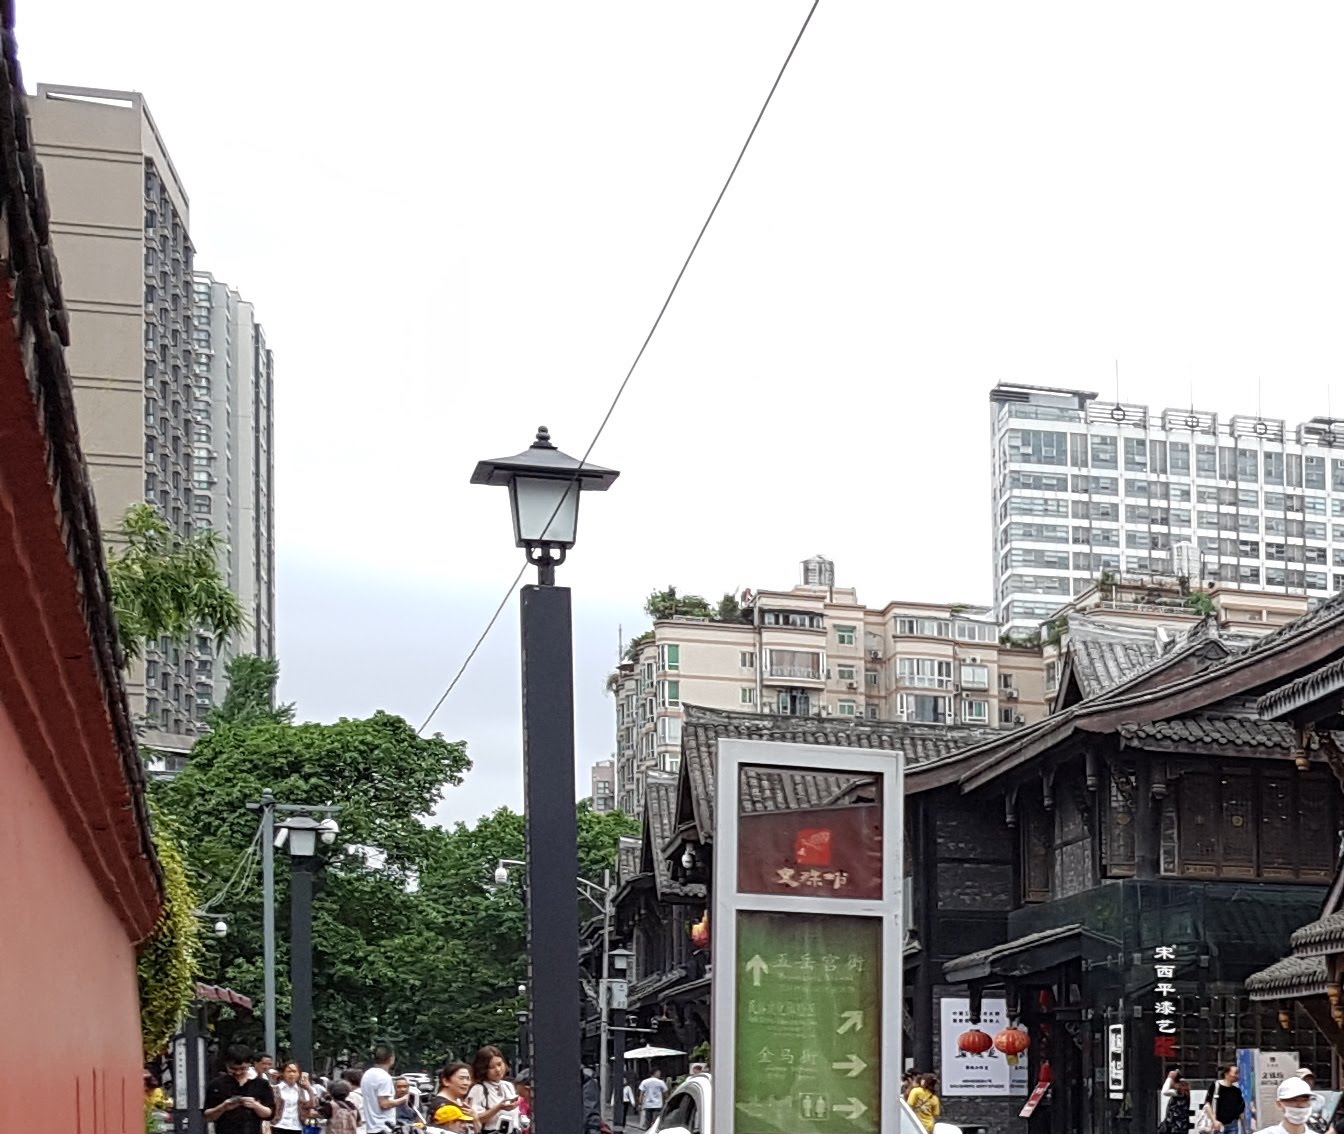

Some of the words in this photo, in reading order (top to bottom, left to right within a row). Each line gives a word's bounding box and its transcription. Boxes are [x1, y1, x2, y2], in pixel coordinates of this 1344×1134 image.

[1154, 945, 1176, 1034] 宋西平漆艺
